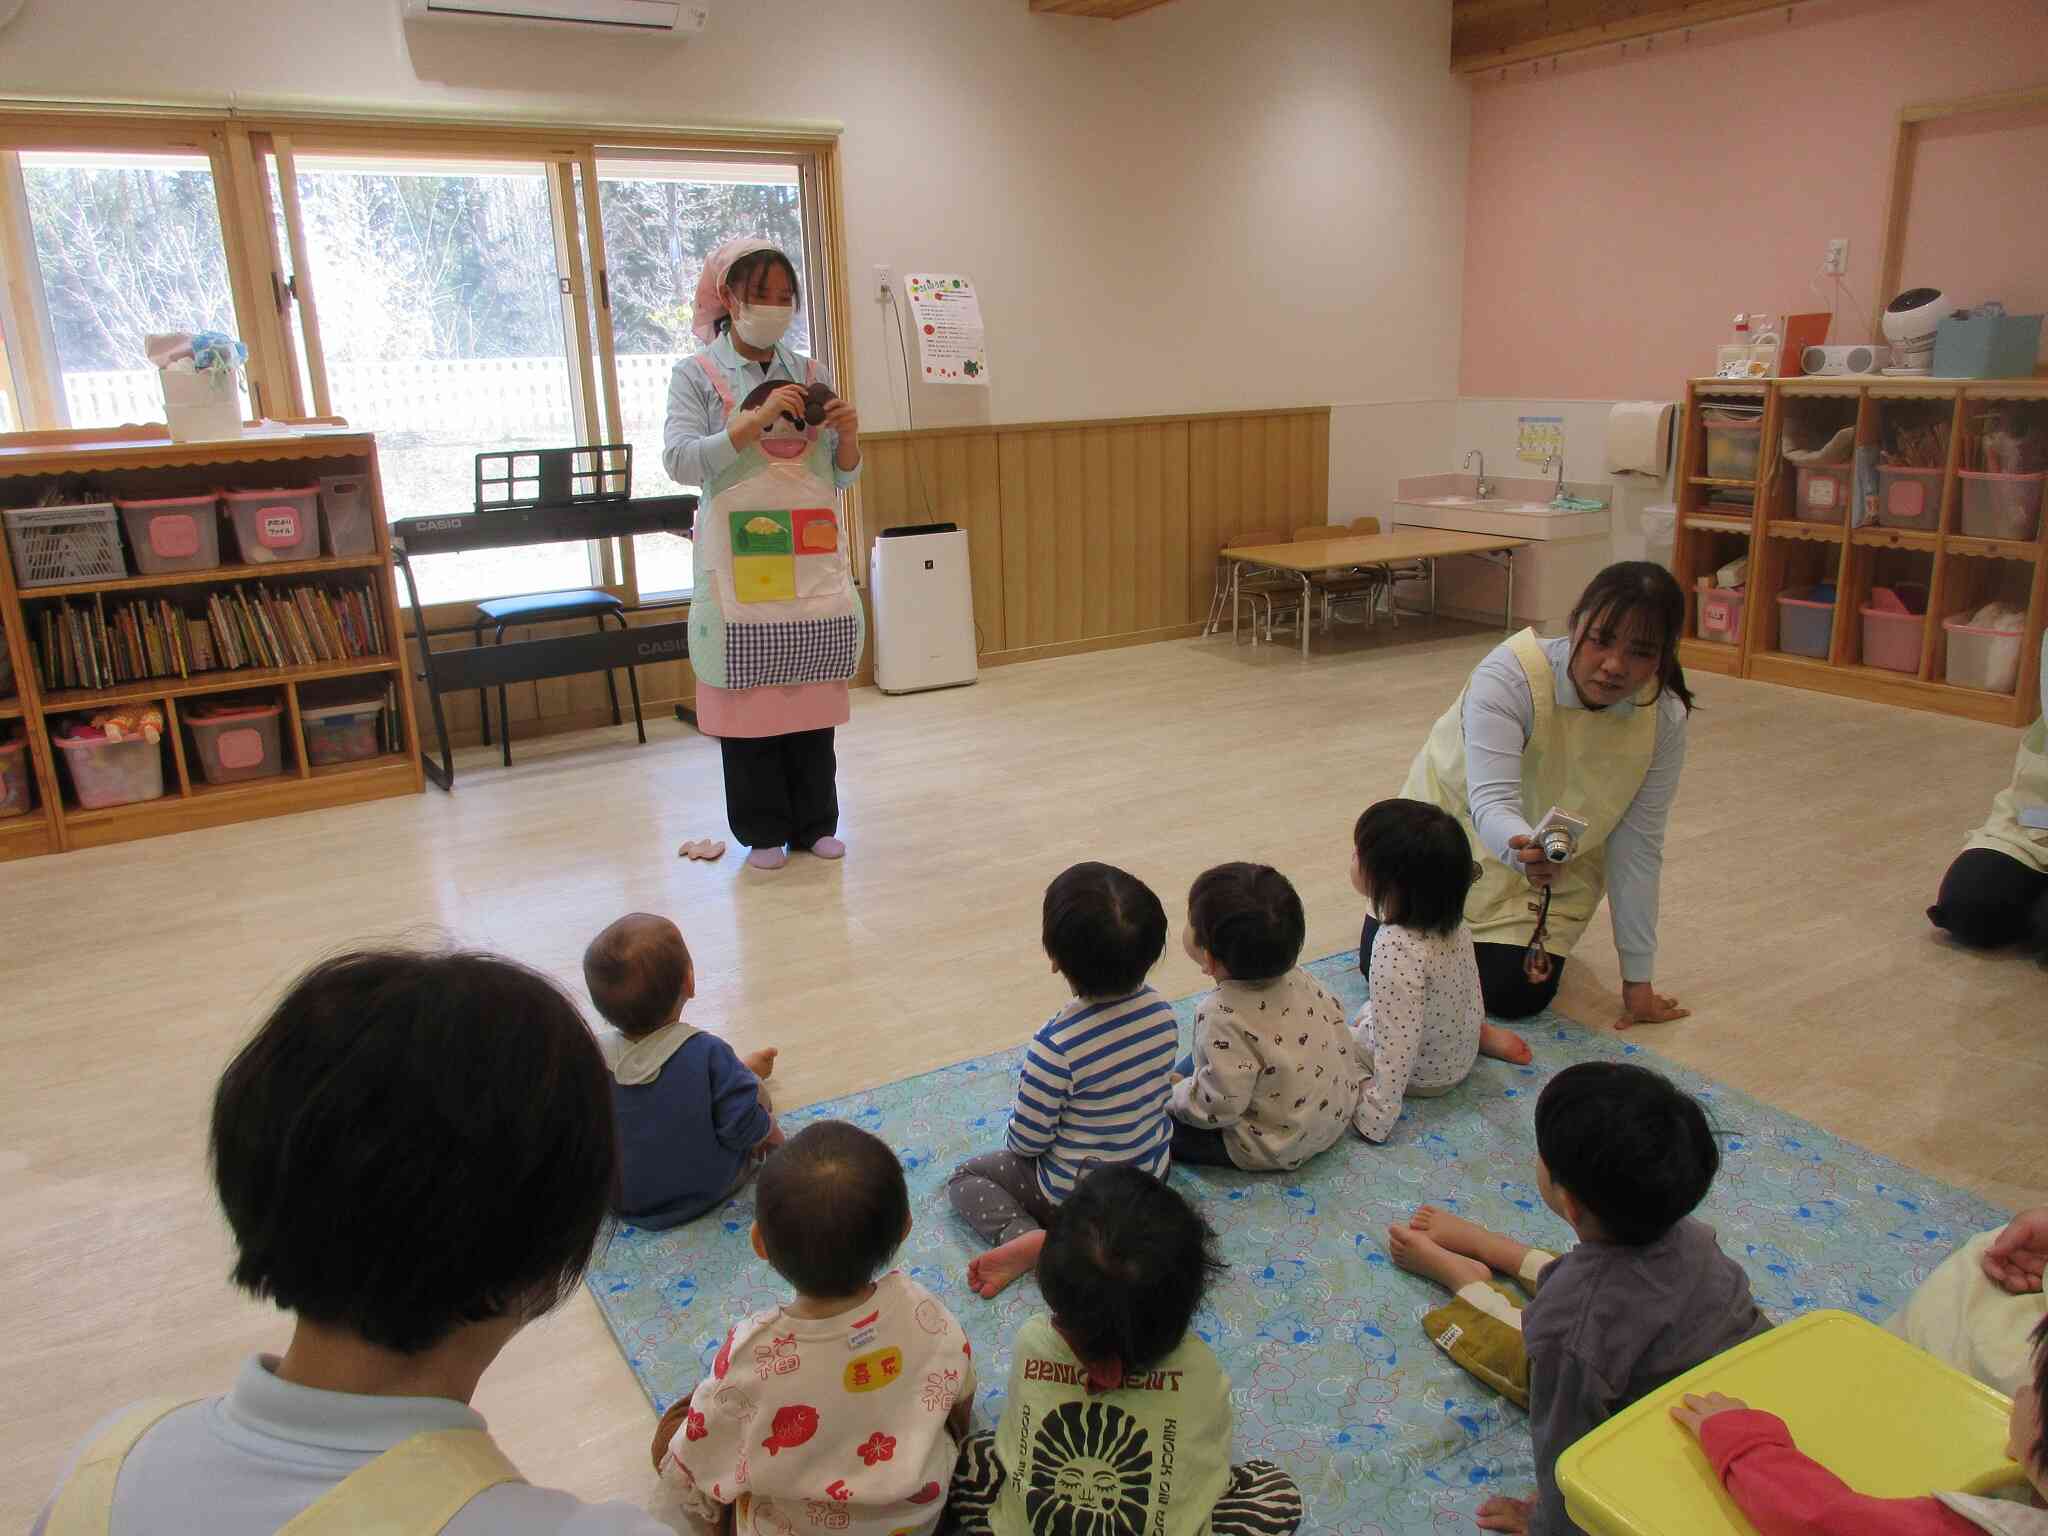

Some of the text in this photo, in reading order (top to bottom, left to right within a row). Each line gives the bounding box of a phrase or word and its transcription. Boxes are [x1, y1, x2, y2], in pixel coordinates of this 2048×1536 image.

[416, 519, 462, 532] CASIO
[1019, 1404, 1032, 1456] WOOD
[1160, 1418, 1177, 1477] KNOCK
[1158, 1482, 1171, 1505] ON
